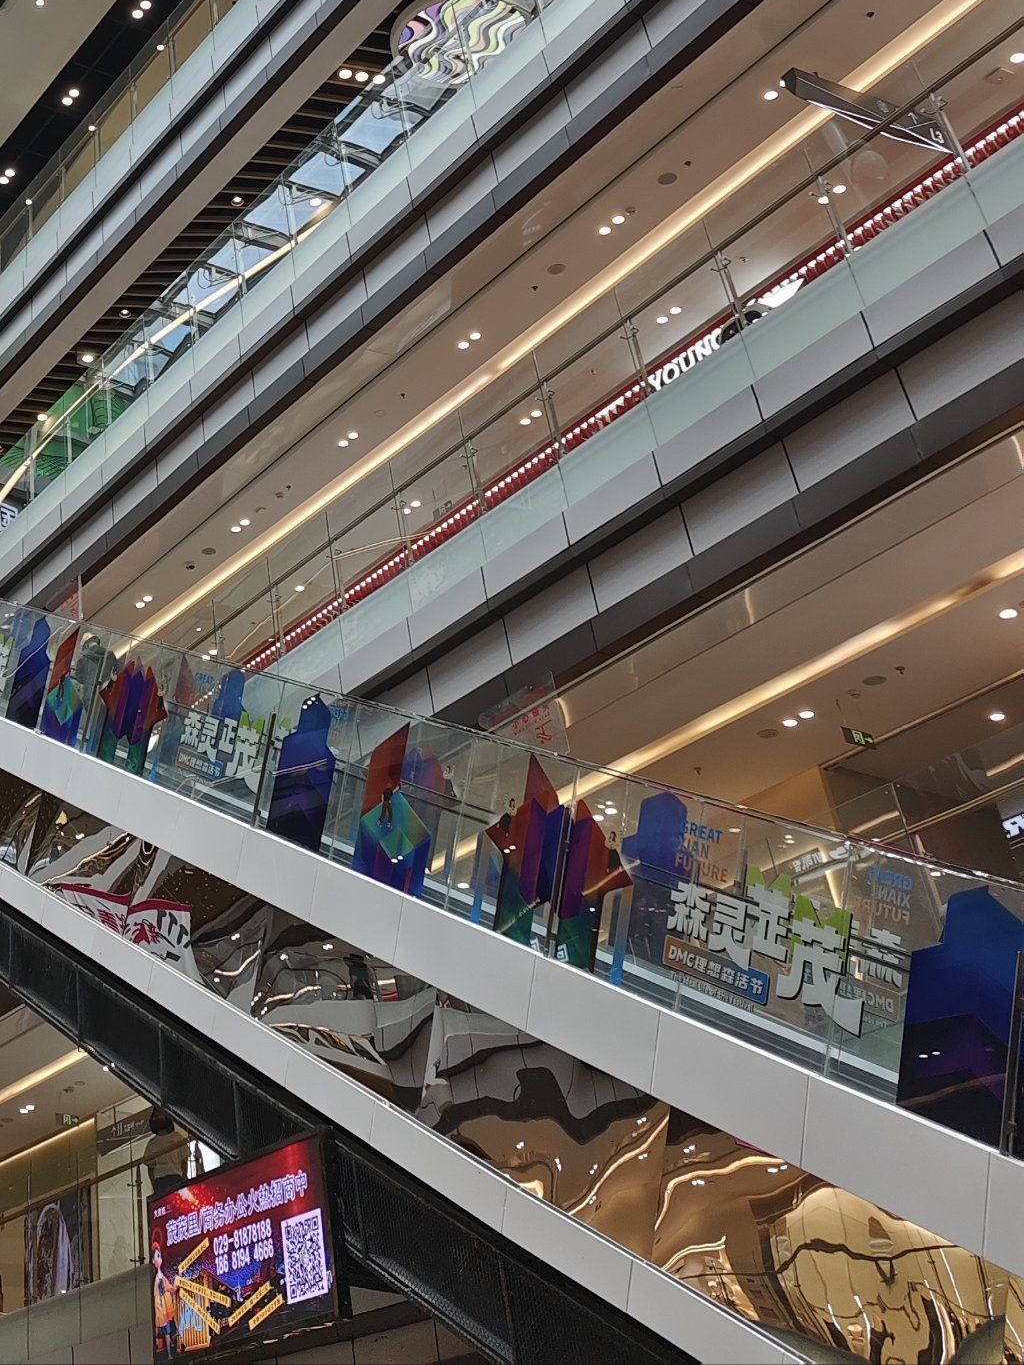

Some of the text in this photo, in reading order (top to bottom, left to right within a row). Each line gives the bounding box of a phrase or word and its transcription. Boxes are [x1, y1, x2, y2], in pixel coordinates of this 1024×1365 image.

[667, 944, 765, 995] DMC理想森活节
[212, 1218, 273, 1256] 029-81878188
[215, 1253, 229, 1275] 186
[231, 1245, 251, 1270] 8194
[253, 1238, 275, 1262] 4666
